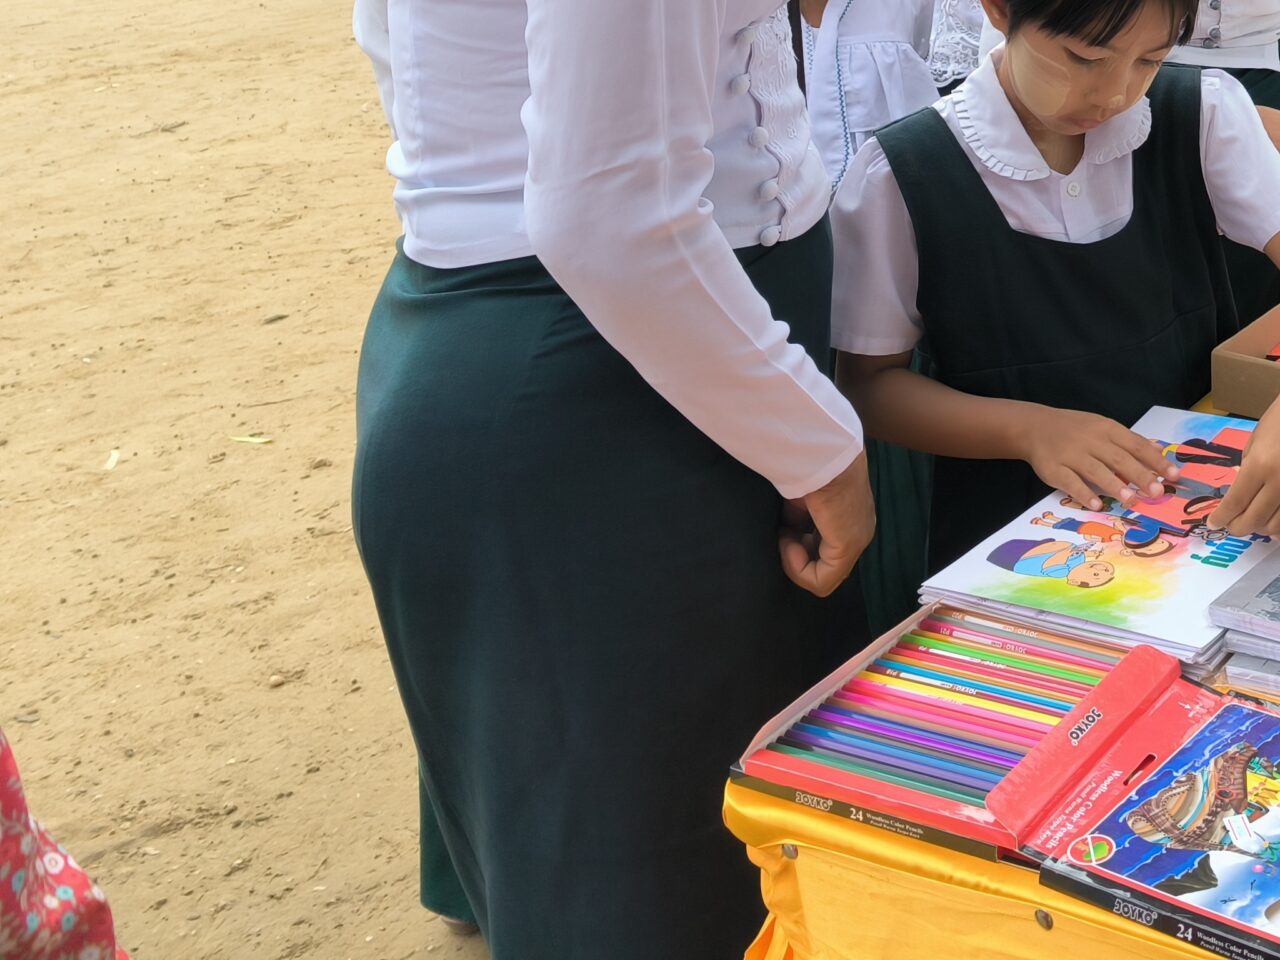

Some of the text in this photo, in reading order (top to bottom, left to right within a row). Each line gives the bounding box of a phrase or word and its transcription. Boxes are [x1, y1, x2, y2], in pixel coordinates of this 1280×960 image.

[1068, 706, 1103, 745] JOYKO
[795, 791, 833, 812] JOYKO
[849, 807, 863, 822] 24
[1045, 770, 1123, 849] Woodless Color Pencils
[1113, 898, 1158, 926] JOYKO
[1176, 923, 1193, 941] 24
[1196, 930, 1224, 948] Woodless
[1225, 942, 1242, 954] Color
